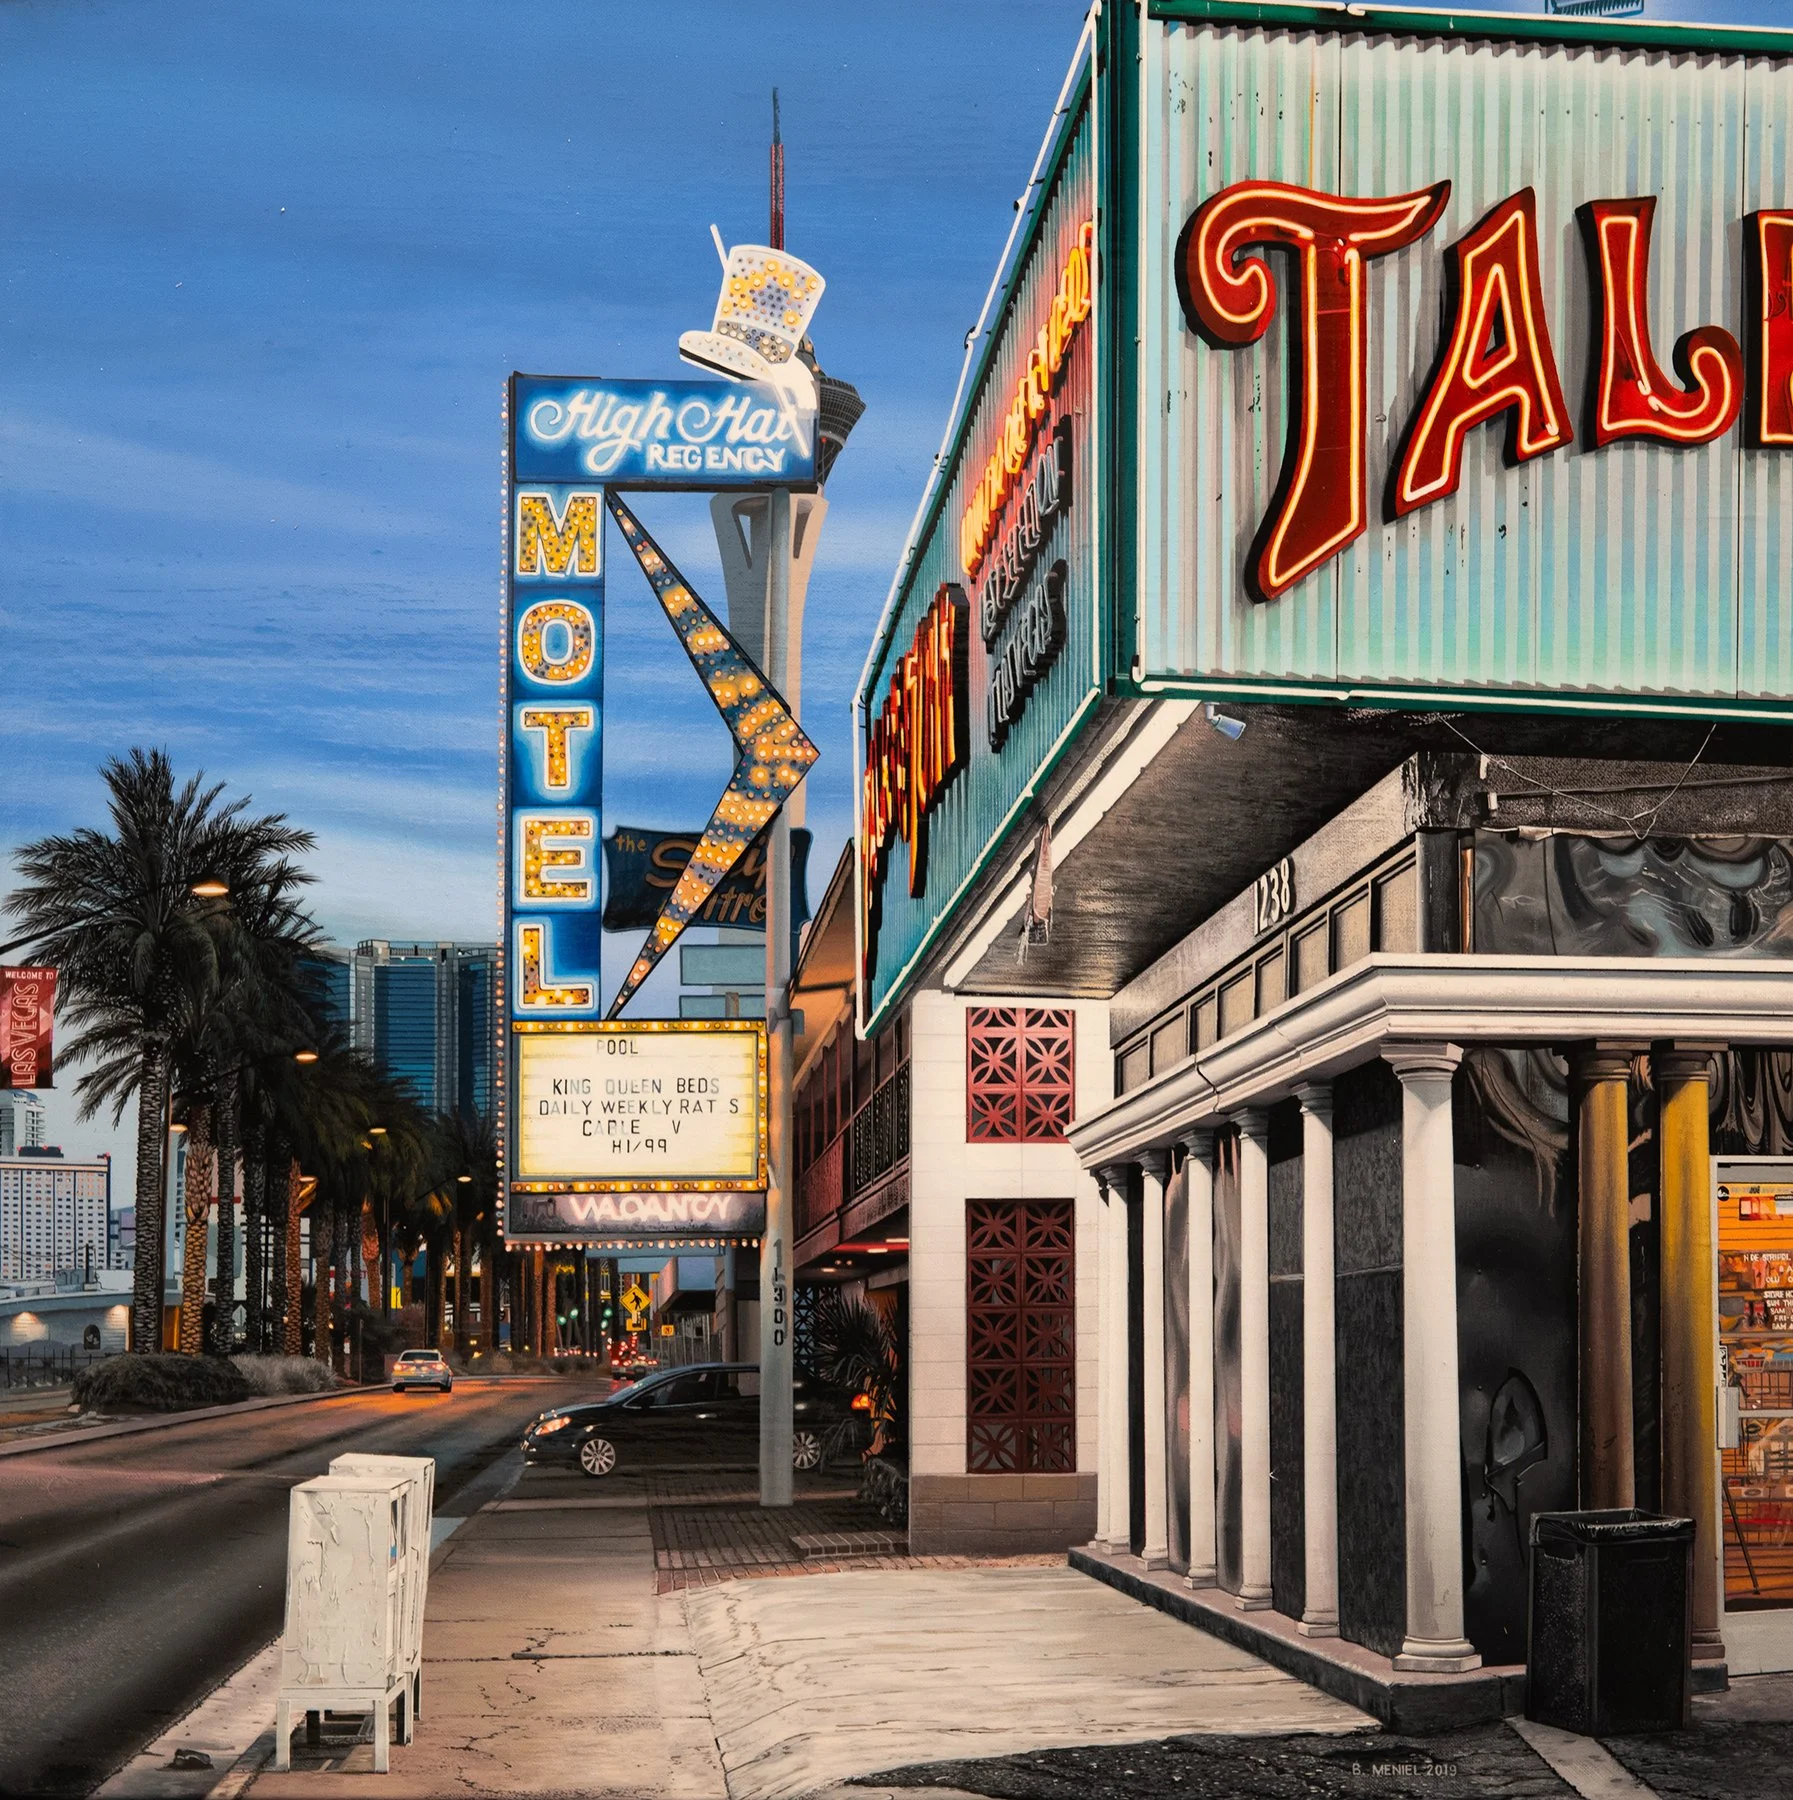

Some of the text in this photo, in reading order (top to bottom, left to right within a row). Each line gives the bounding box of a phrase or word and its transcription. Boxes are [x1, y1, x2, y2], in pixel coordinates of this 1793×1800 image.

[1176, 178, 1793, 602] TAL
[530, 391, 671, 473] High
[649, 444, 786, 472] REGENCY
[517, 491, 603, 1010] MOTEL
[615, 834, 648, 853] the
[1254, 857, 1291, 938] 1238
[5, 970, 54, 980] WELCOME TO
[10, 982, 39, 1086] LAS VEGAS
[597, 1038, 639, 1055] POOL
[552, 1077, 720, 1095] KING QUEEN BEDS
[539, 1099, 592, 1116] DAILY
[601, 1099, 671, 1114] WEEKLY
[1352, 1763, 1457, 1776] B. MENIEL 2019
